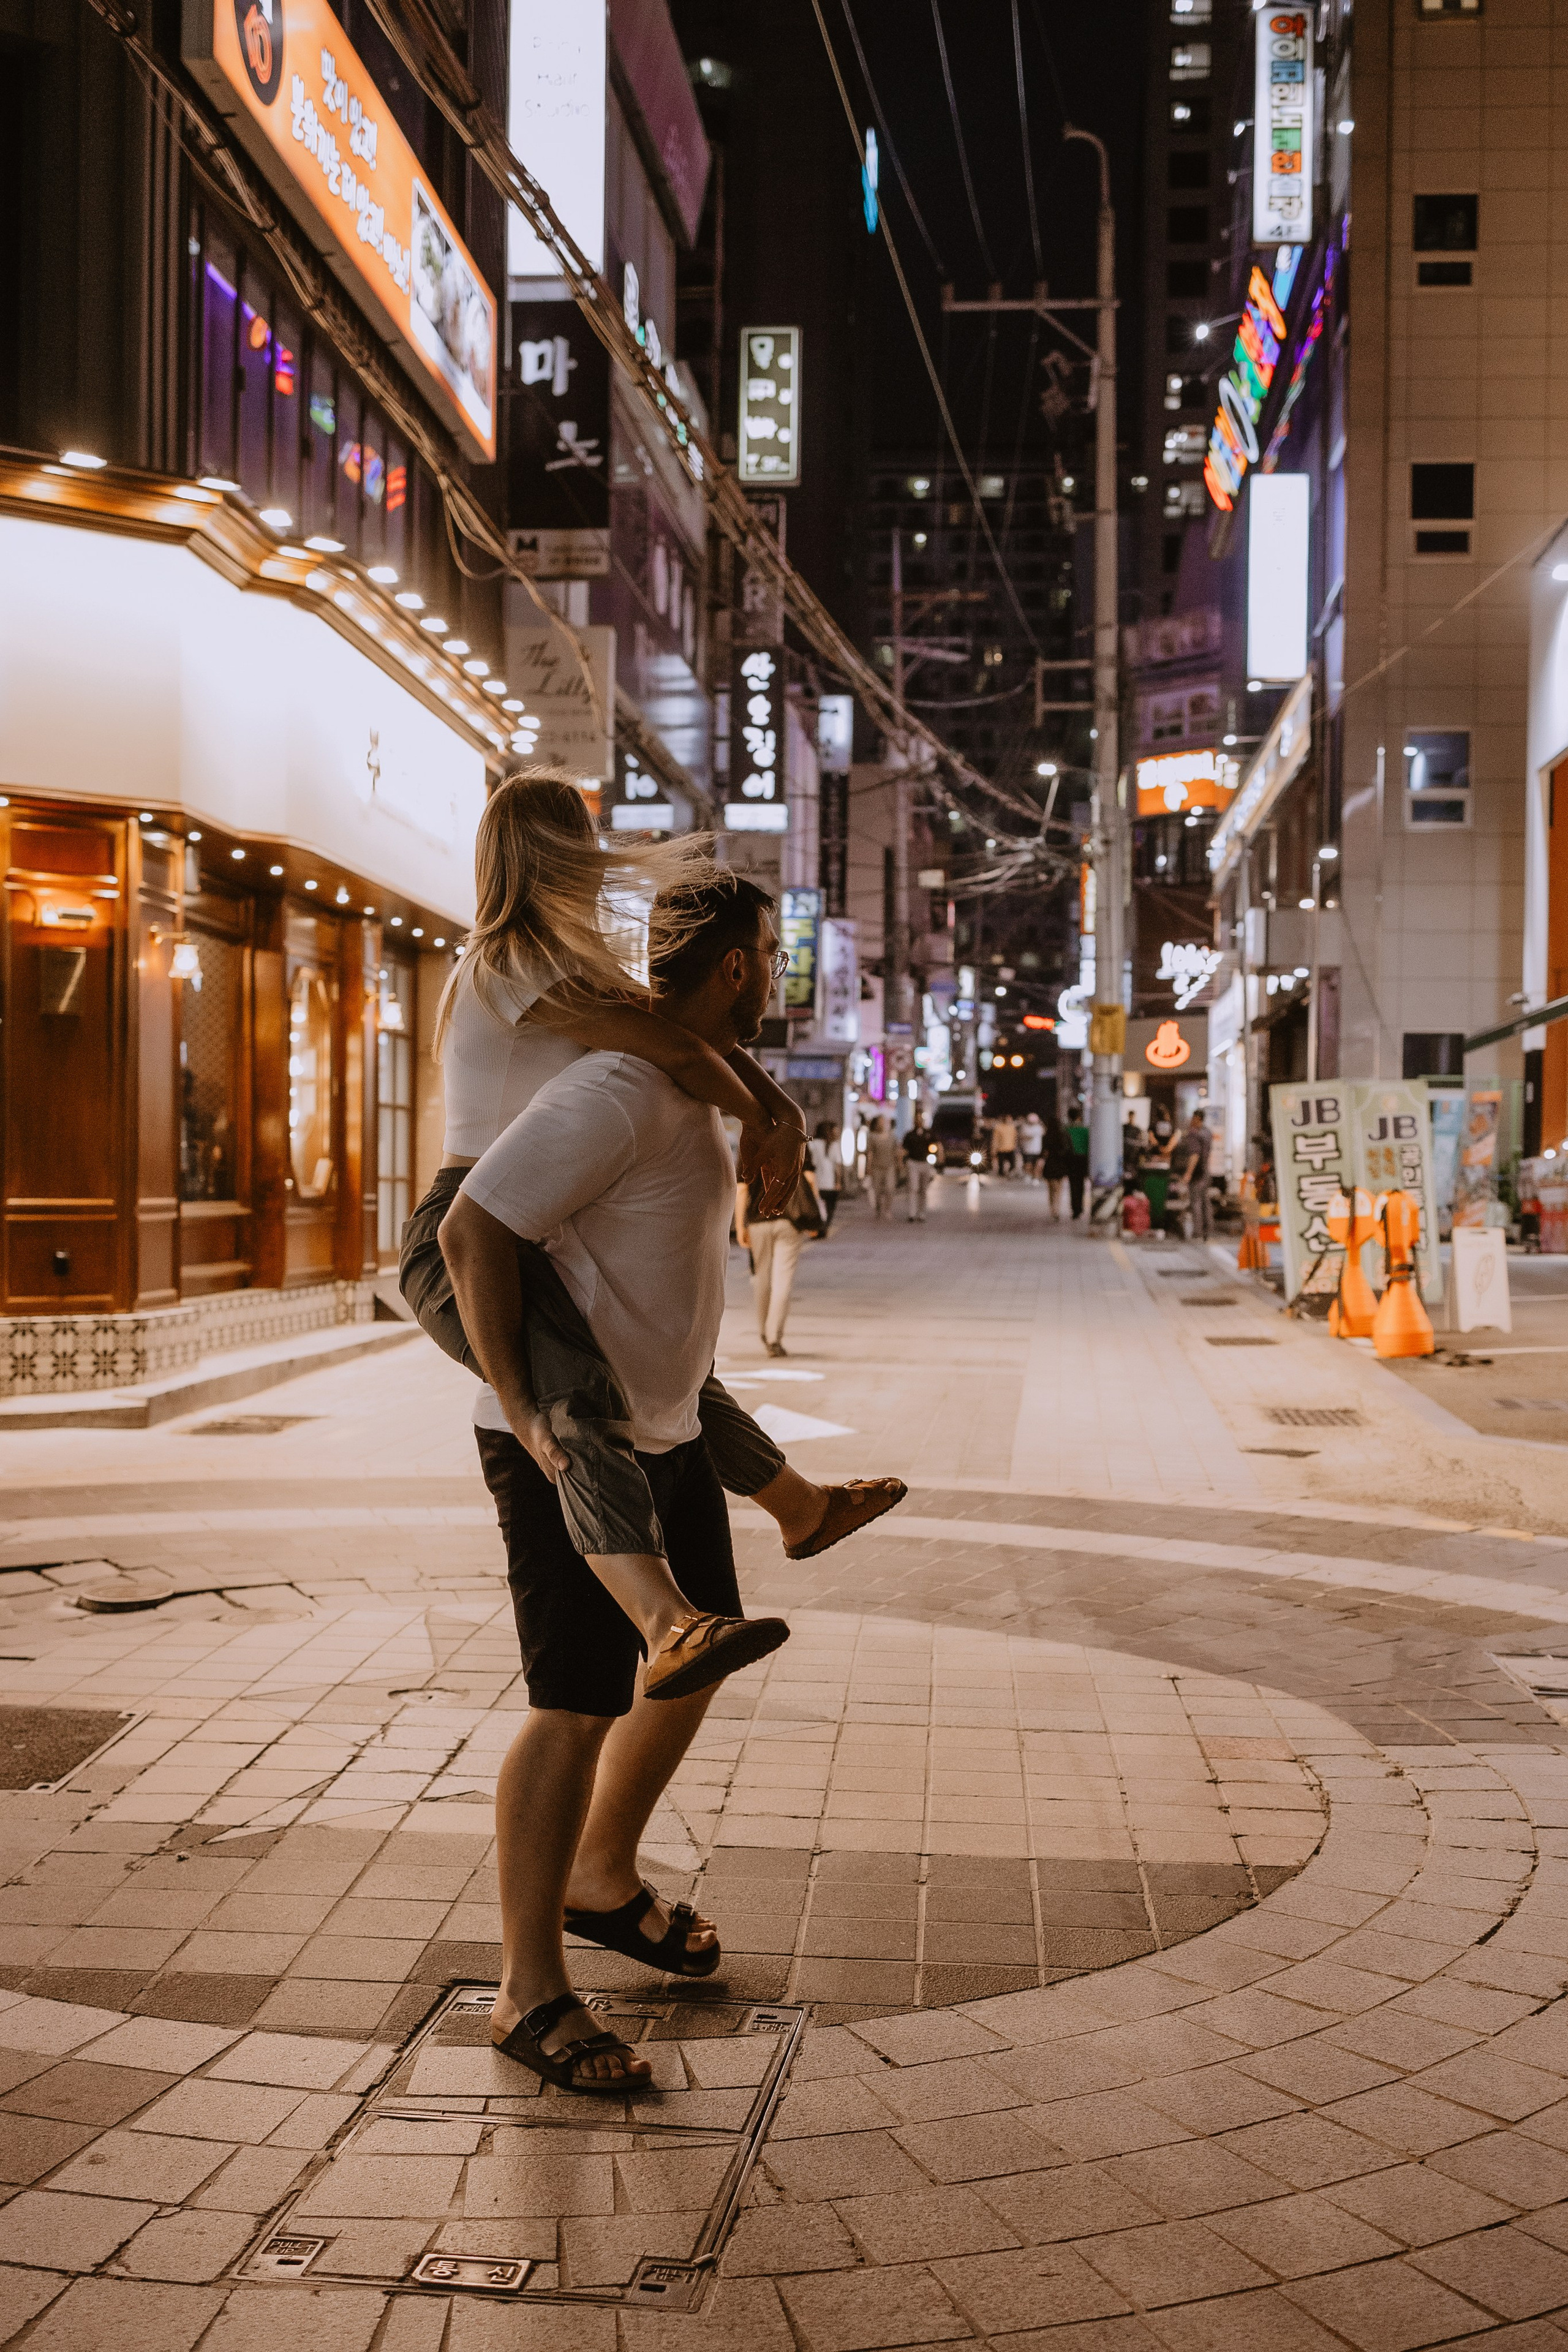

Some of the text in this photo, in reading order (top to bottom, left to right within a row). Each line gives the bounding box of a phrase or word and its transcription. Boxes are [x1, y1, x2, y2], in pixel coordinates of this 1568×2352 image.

[1268, 224, 1302, 239] 4F
[1291, 1098, 1341, 1127] JB
[1368, 1116, 1418, 1140] JB
[270, 2241, 303, 2249] PULL
